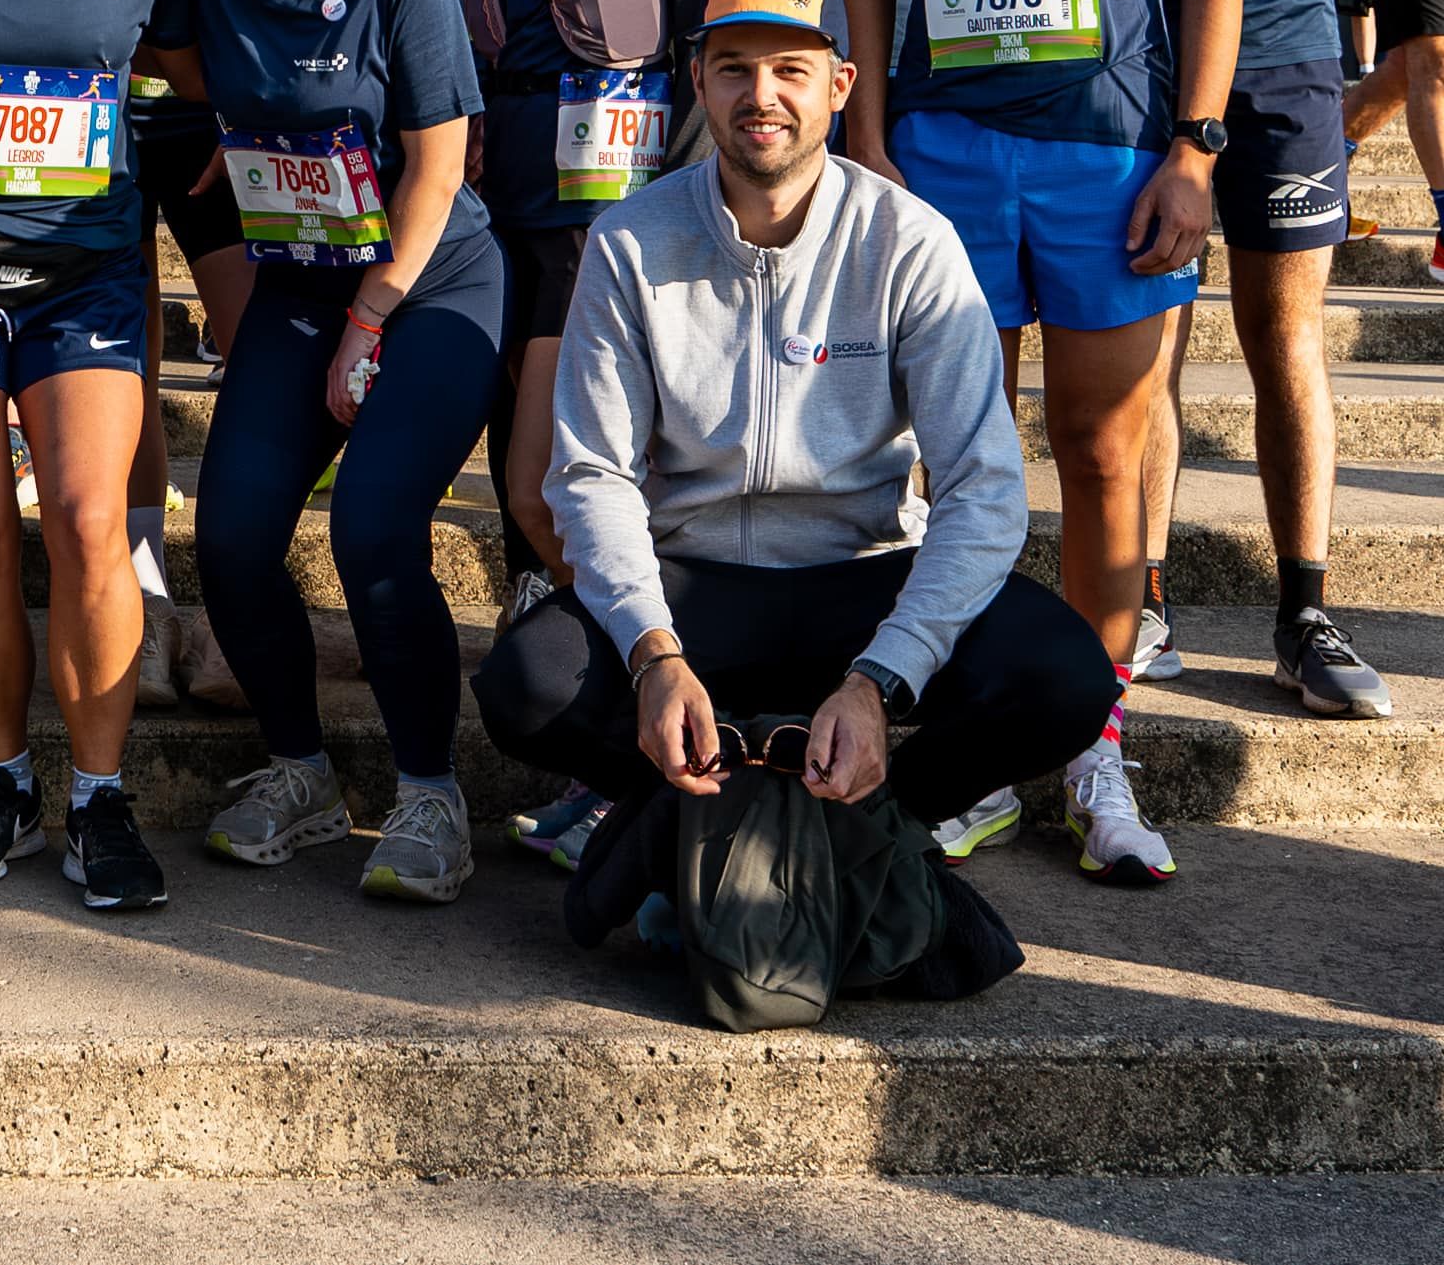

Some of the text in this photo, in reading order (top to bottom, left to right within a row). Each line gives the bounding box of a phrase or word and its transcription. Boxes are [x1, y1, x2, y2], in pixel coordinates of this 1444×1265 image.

[967, 12, 1053, 33] GAUTHIER BRUNEL
[294, 59, 329, 67] VINCI
[606, 108, 665, 149] 7071
[7, 149, 45, 163] LEGROS
[598, 151, 629, 166] BOLTZ
[267, 157, 331, 196] 7643
[831, 342, 876, 353] SOGEA
